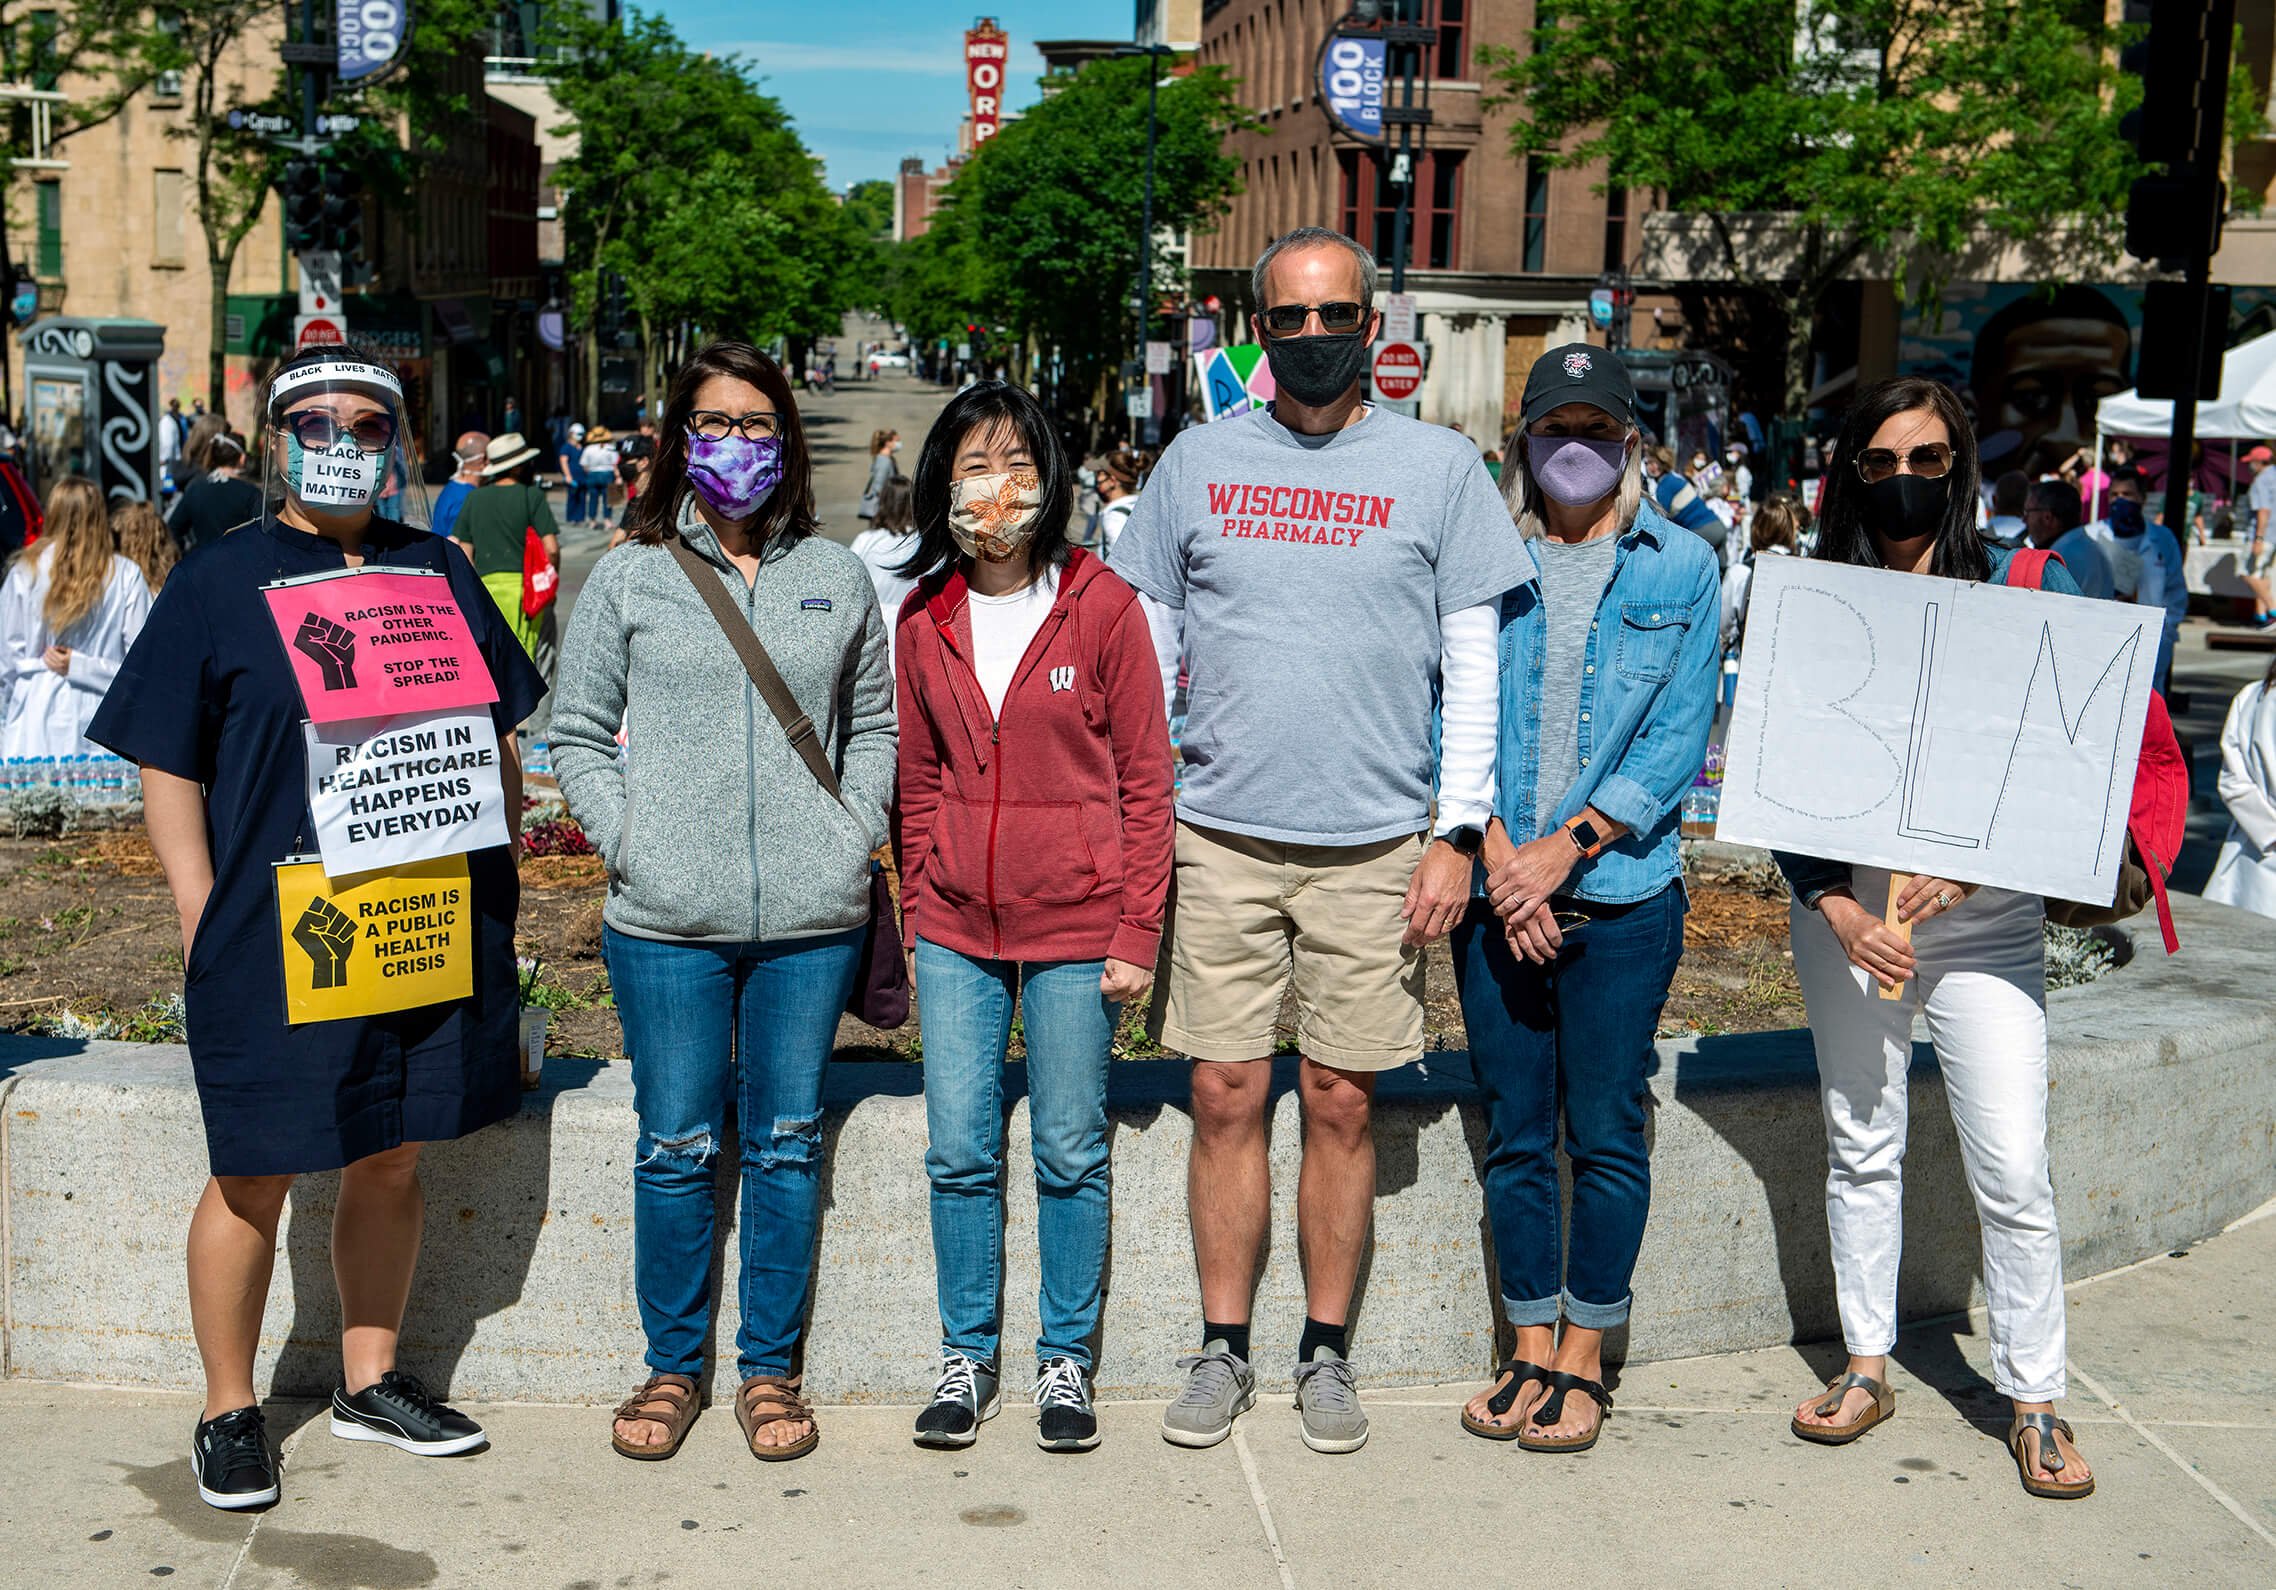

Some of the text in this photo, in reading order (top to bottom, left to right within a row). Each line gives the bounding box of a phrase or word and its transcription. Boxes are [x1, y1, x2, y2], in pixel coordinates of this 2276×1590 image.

[968, 43, 1005, 59] NEW
[1330, 41, 1364, 115] 100
[1361, 56, 1383, 120] BLOCK
[1381, 353, 1415, 363] DO NOT
[289, 366, 322, 381] BLACK
[335, 364, 366, 373] LIVES
[1381, 378, 1414, 390] ENTER
[315, 446, 366, 462] BLACK
[316, 464, 361, 480] LIVES
[305, 482, 367, 499] MATTER
[1207, 483, 1395, 529] WISCONSIN
[1221, 519, 1364, 547] PHARMACY
[345, 604, 456, 622] RACISM IS THE
[382, 618, 434, 630] OTHER
[370, 630, 453, 646] PANDEMIC.
[383, 656, 460, 674] STOP THE
[392, 671, 460, 688] SPREAD!
[335, 726, 472, 766] RACISM IN
[318, 748, 493, 795] HEALTHCARE
[350, 777, 472, 816] HAPPENS
[347, 801, 482, 844] EVERYDAY
[359, 889, 460, 918] RACISM IS
[365, 910, 456, 938] A PUBLIC
[374, 931, 450, 958] HEALTH
[382, 953, 445, 978] CRISIS
